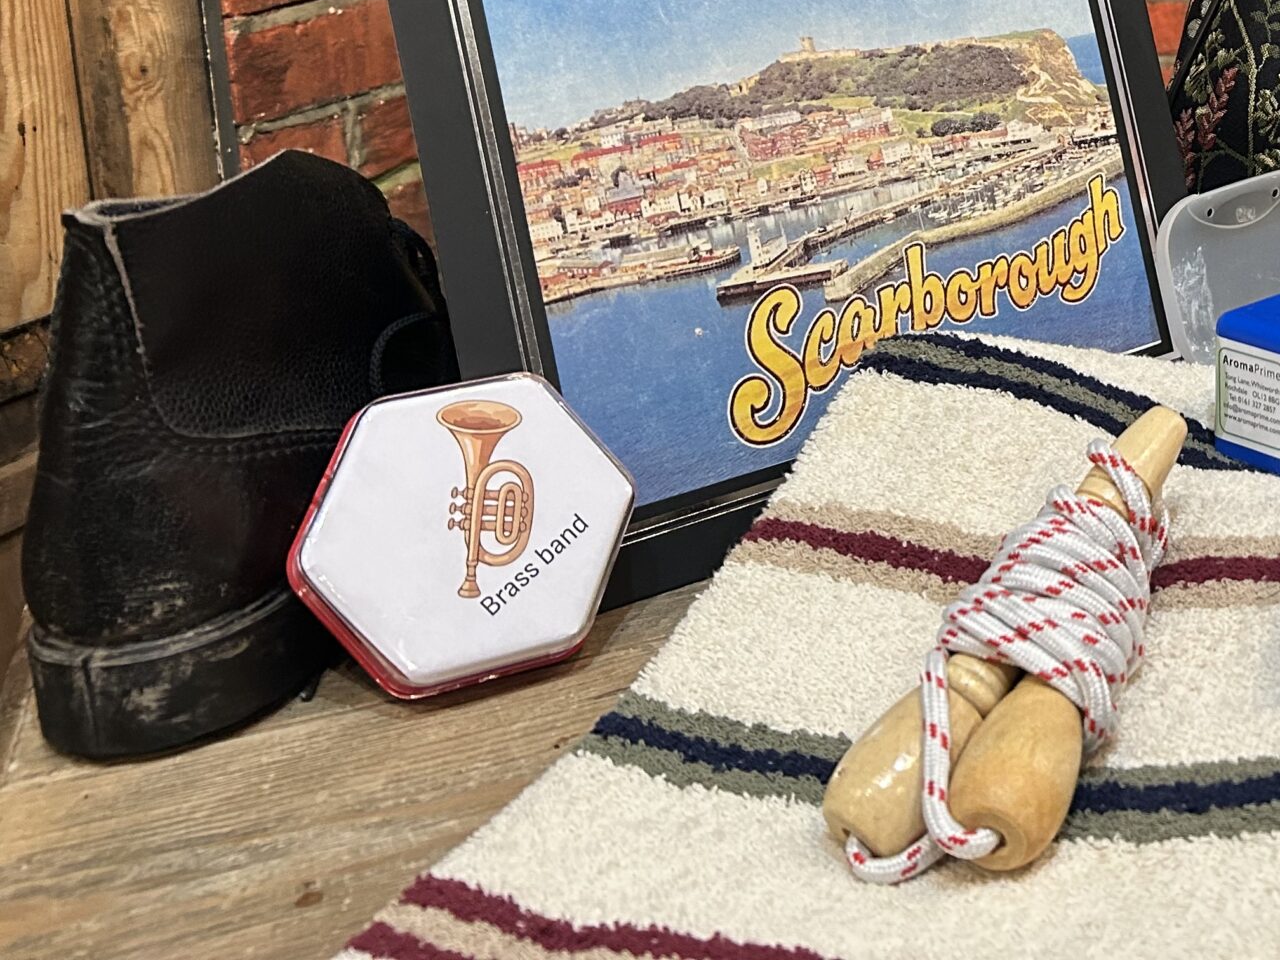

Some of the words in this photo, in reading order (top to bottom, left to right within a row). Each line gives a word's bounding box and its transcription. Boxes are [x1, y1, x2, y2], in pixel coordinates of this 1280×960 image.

[727, 171, 1126, 449] Scarborough
[1252, 390, 1267, 402] OL12
[1252, 399, 1262, 409] 327
[480, 561, 540, 616] Brass
[535, 513, 590, 565] band
